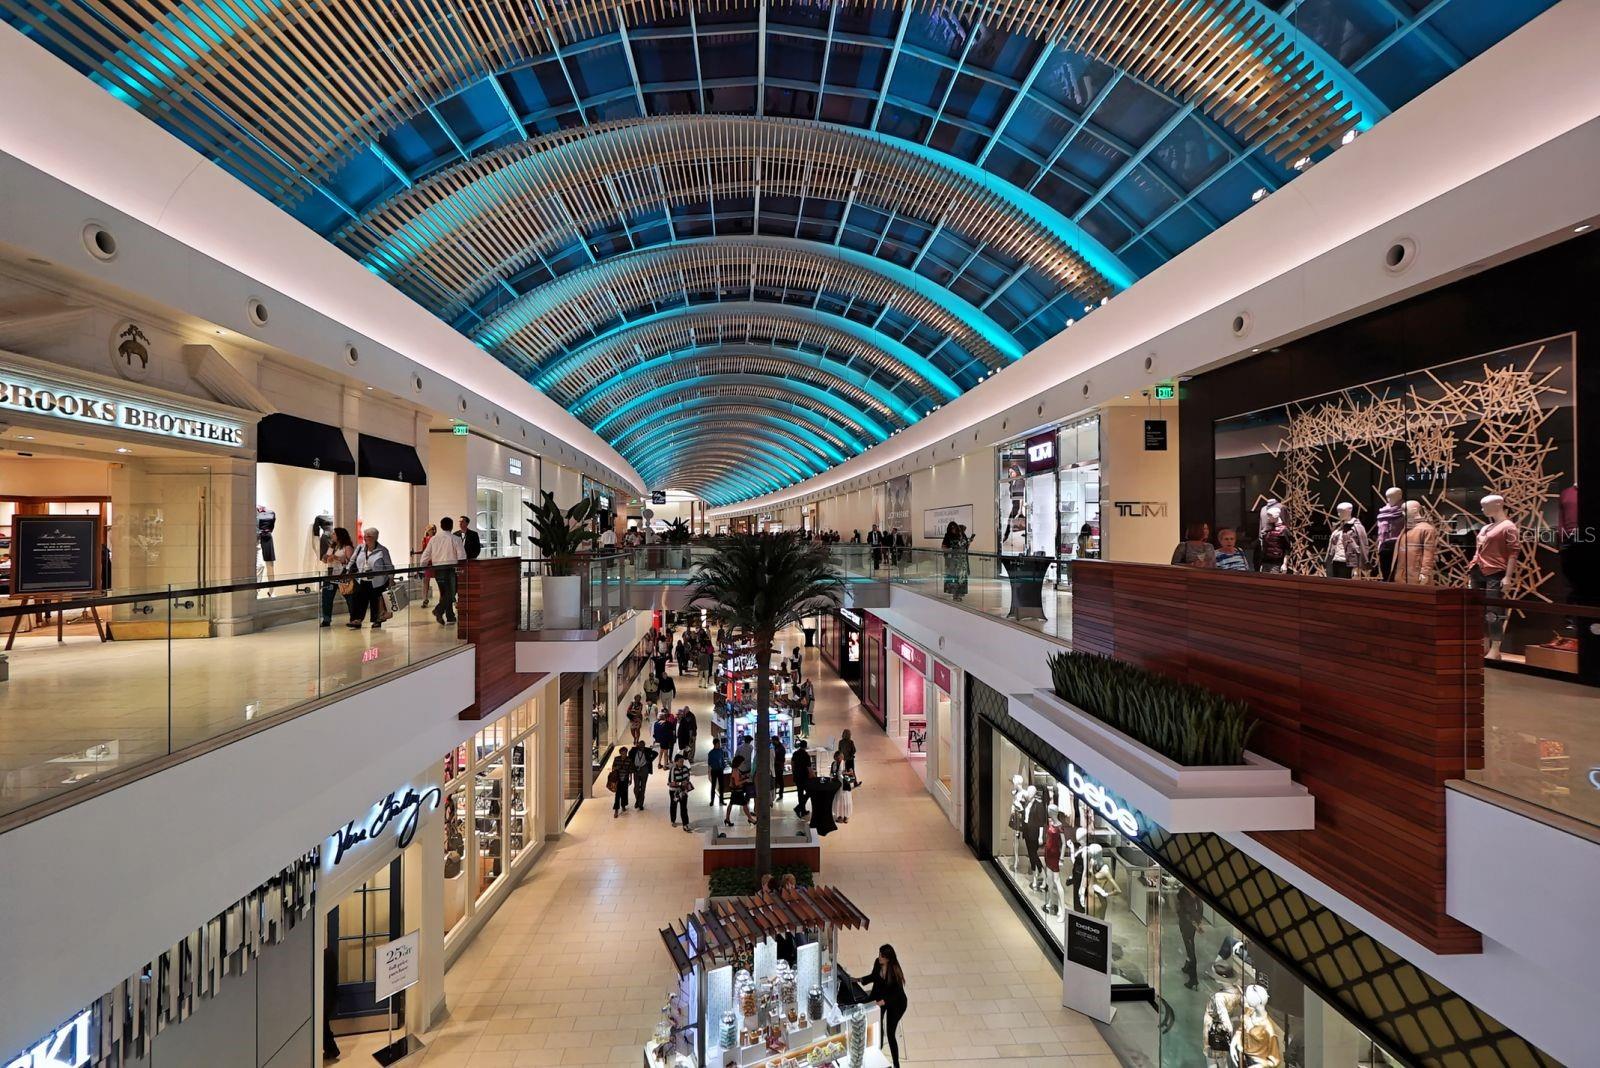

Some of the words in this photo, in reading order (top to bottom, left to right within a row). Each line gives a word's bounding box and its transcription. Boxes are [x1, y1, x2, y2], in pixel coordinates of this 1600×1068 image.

[124, 406, 243, 444] BROTHERS
[1114, 501, 1168, 517] TUMI
[1068, 763, 1139, 837] bebe
[1075, 921, 1101, 935] bebe
[3, 1009, 92, 1068] KI
